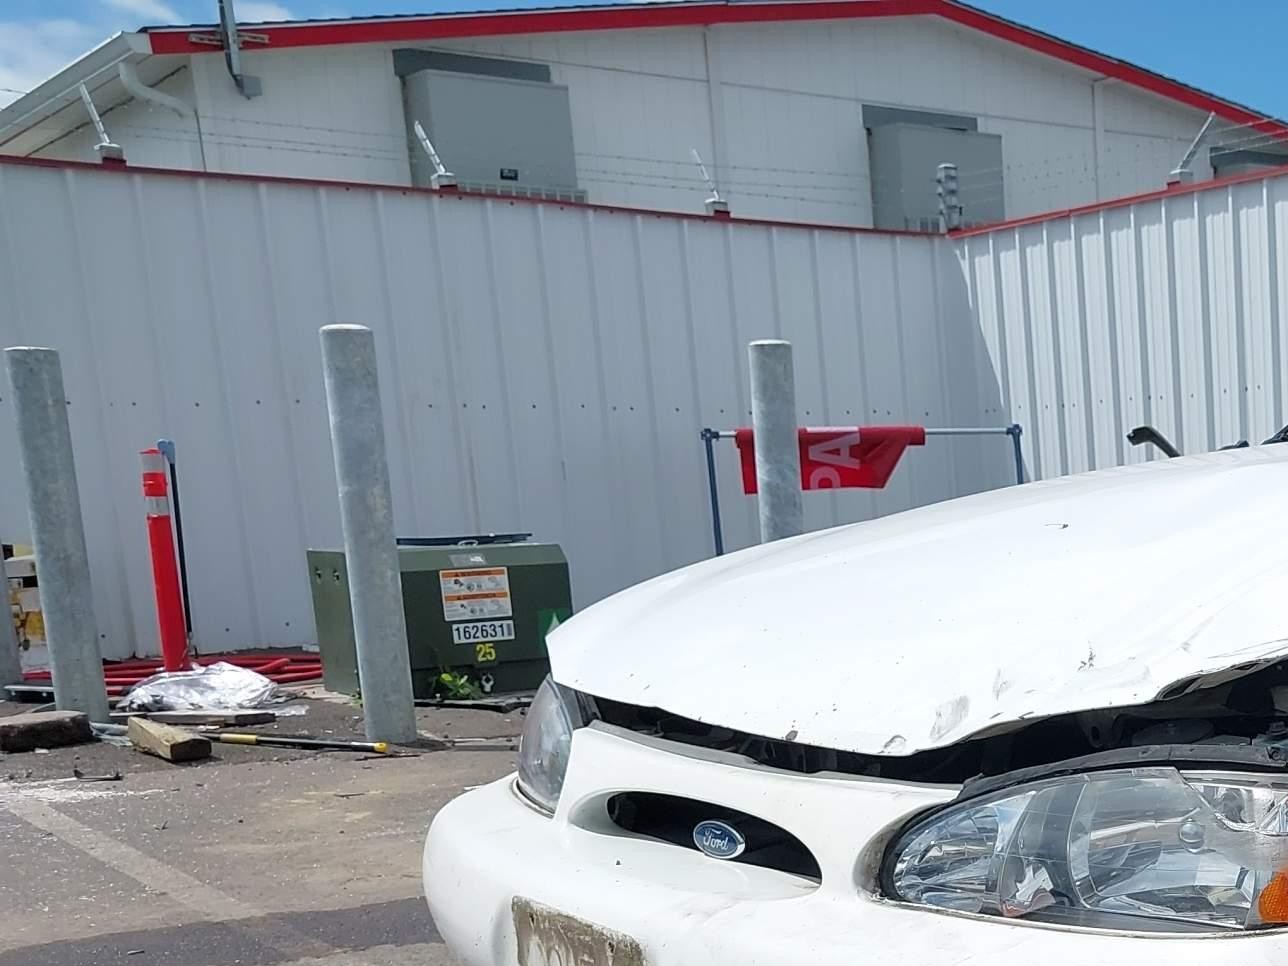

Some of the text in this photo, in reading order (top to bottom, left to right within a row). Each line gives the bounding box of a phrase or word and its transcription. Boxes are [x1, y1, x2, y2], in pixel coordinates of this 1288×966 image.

[454, 623, 505, 641] 162631
[476, 643, 496, 662] 25
[703, 828, 729, 850] Ford
